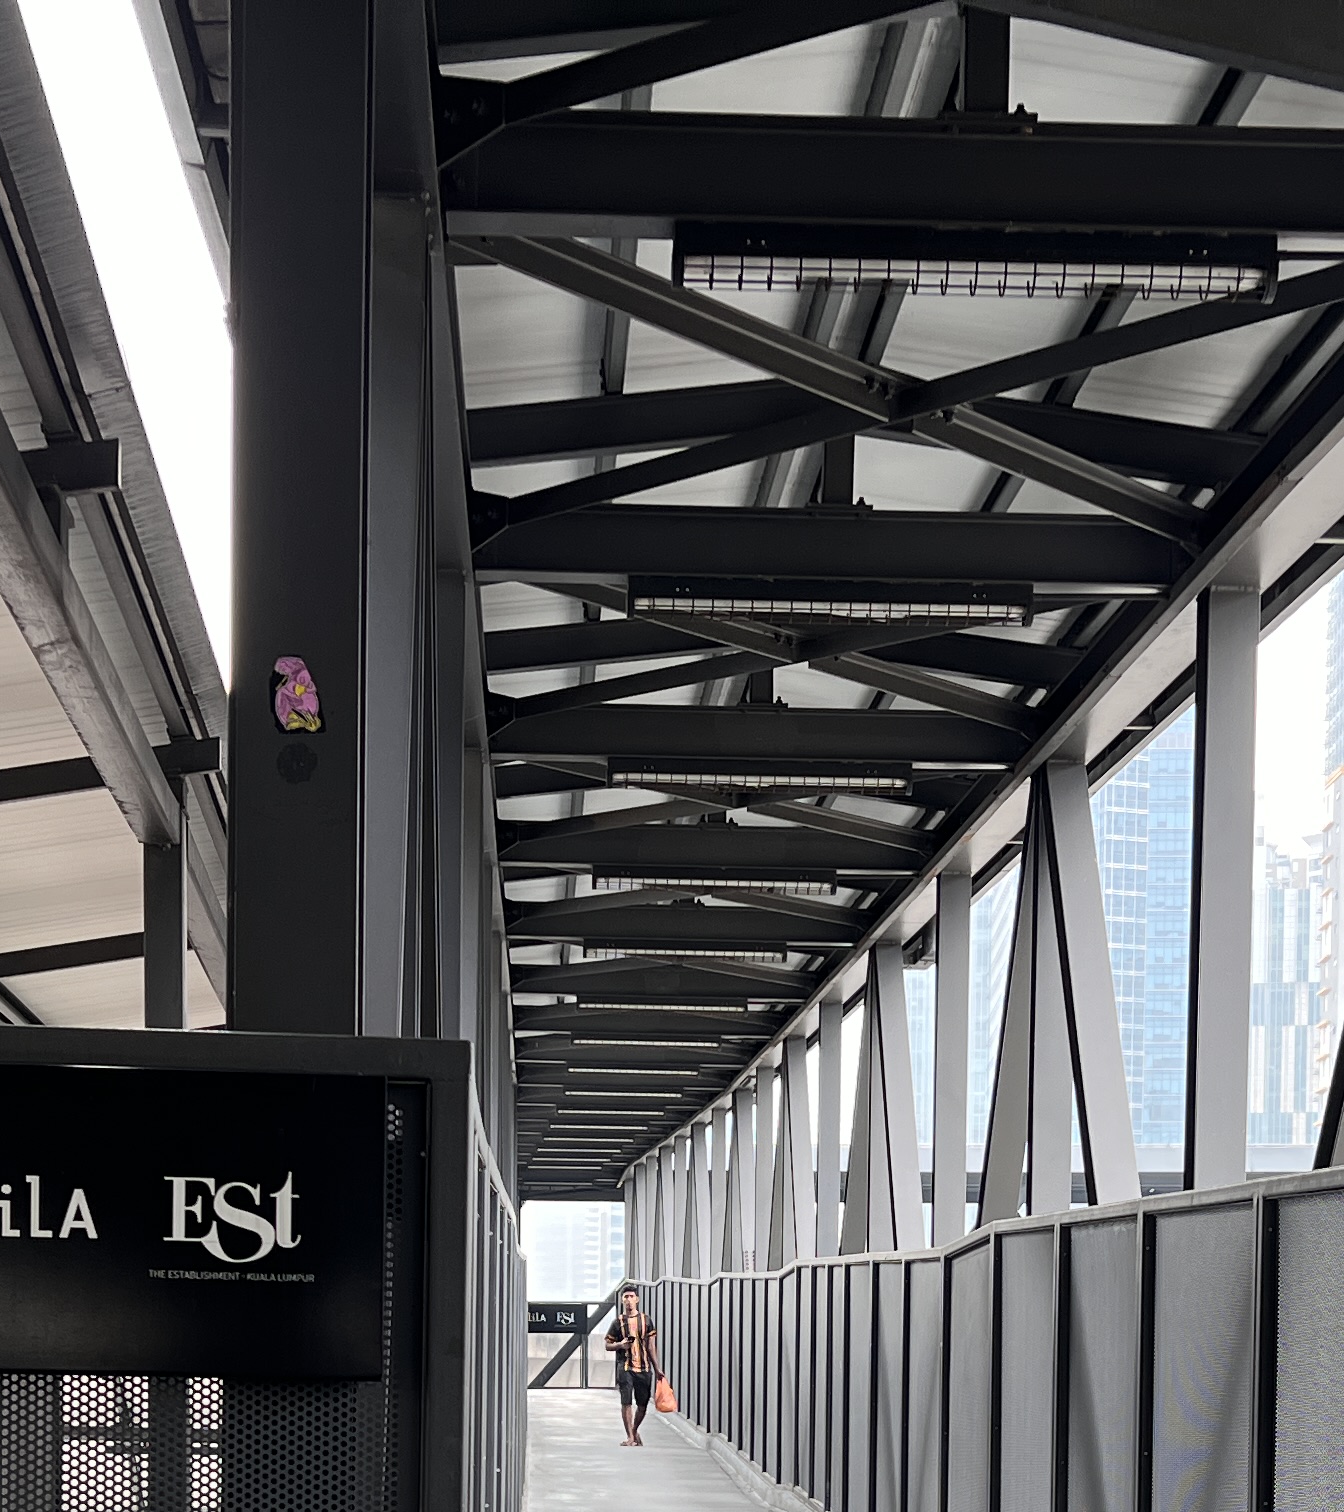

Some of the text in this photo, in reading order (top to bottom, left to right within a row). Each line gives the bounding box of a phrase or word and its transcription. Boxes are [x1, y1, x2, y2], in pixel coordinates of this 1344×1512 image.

[148, 1269, 315, 1283] THE ESTABLISHMENT KUALA LUMPUR
